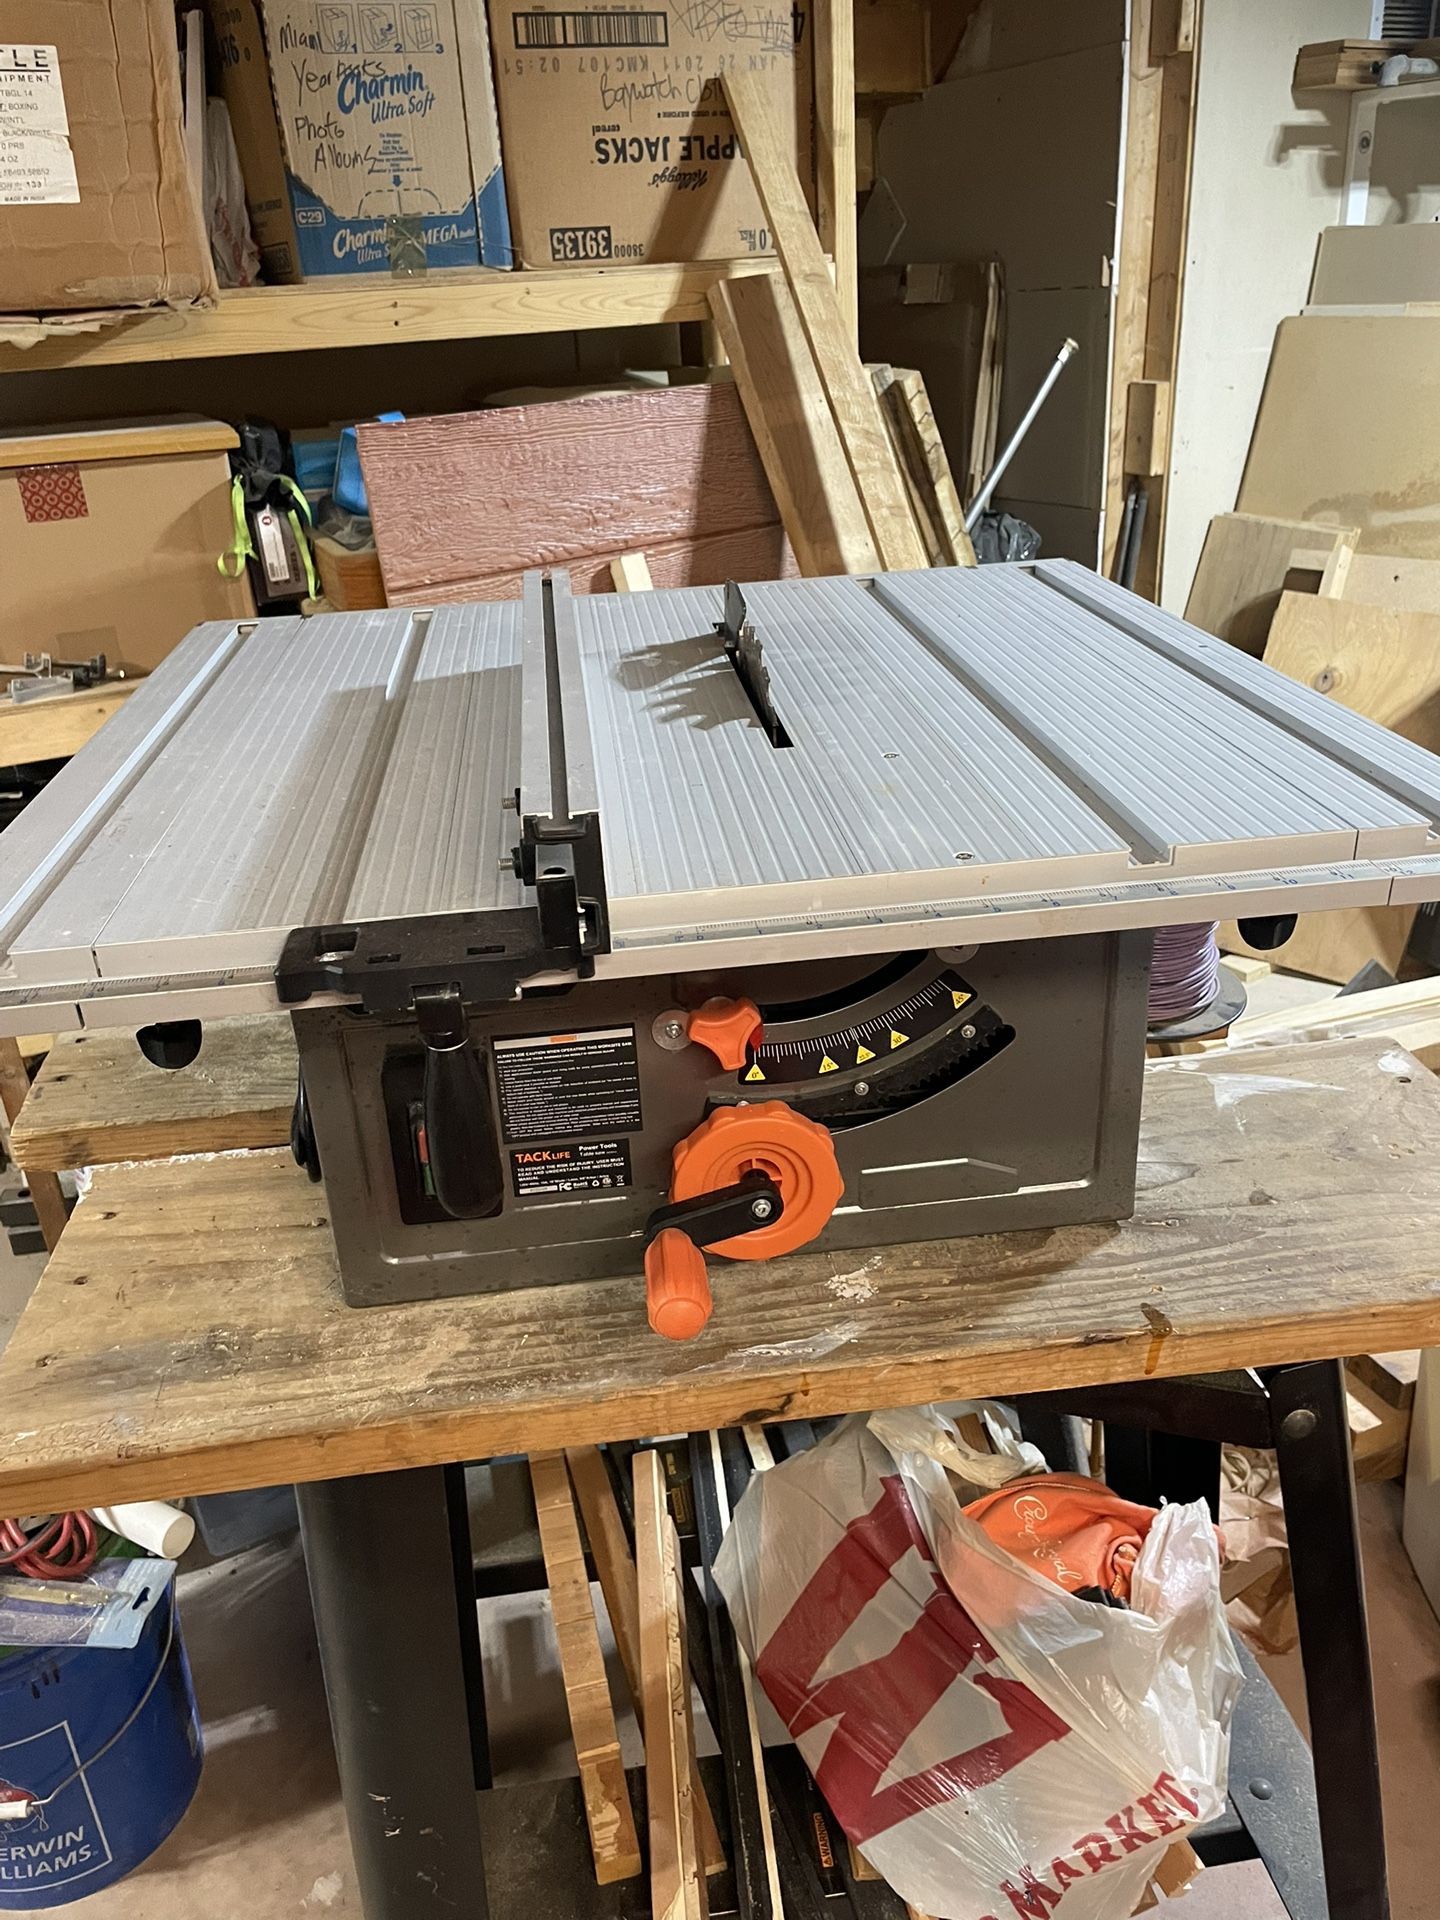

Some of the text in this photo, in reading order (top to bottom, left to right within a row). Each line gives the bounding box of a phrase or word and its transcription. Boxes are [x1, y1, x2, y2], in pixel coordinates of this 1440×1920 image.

[0, 49, 49, 67] LE
[351, 43, 444, 54] 1 2 3
[503, 56, 560, 75] 02:51
[662, 55, 703, 72] 2011
[337, 64, 425, 115] Charmin
[8, 103, 39, 111] BOXING
[371, 90, 437, 125] Ultra Soft
[294, 112, 346, 144] Photo
[593, 124, 620, 136] cereal
[314, 144, 380, 175] Albums
[596, 136, 669, 164] JACKS
[652, 168, 708, 191] Kellogg's
[553, 227, 644, 260] 38000 39135
[356, 247, 382, 266] Ultra
[515, 1151, 571, 1164] TACKLIFE
[578, 1144, 599, 1152] Power
[600, 1142, 618, 1150] Tools
[813, 1813, 833, 1857] WARNING
[999, 1770, 1200, 1920] MARKET
